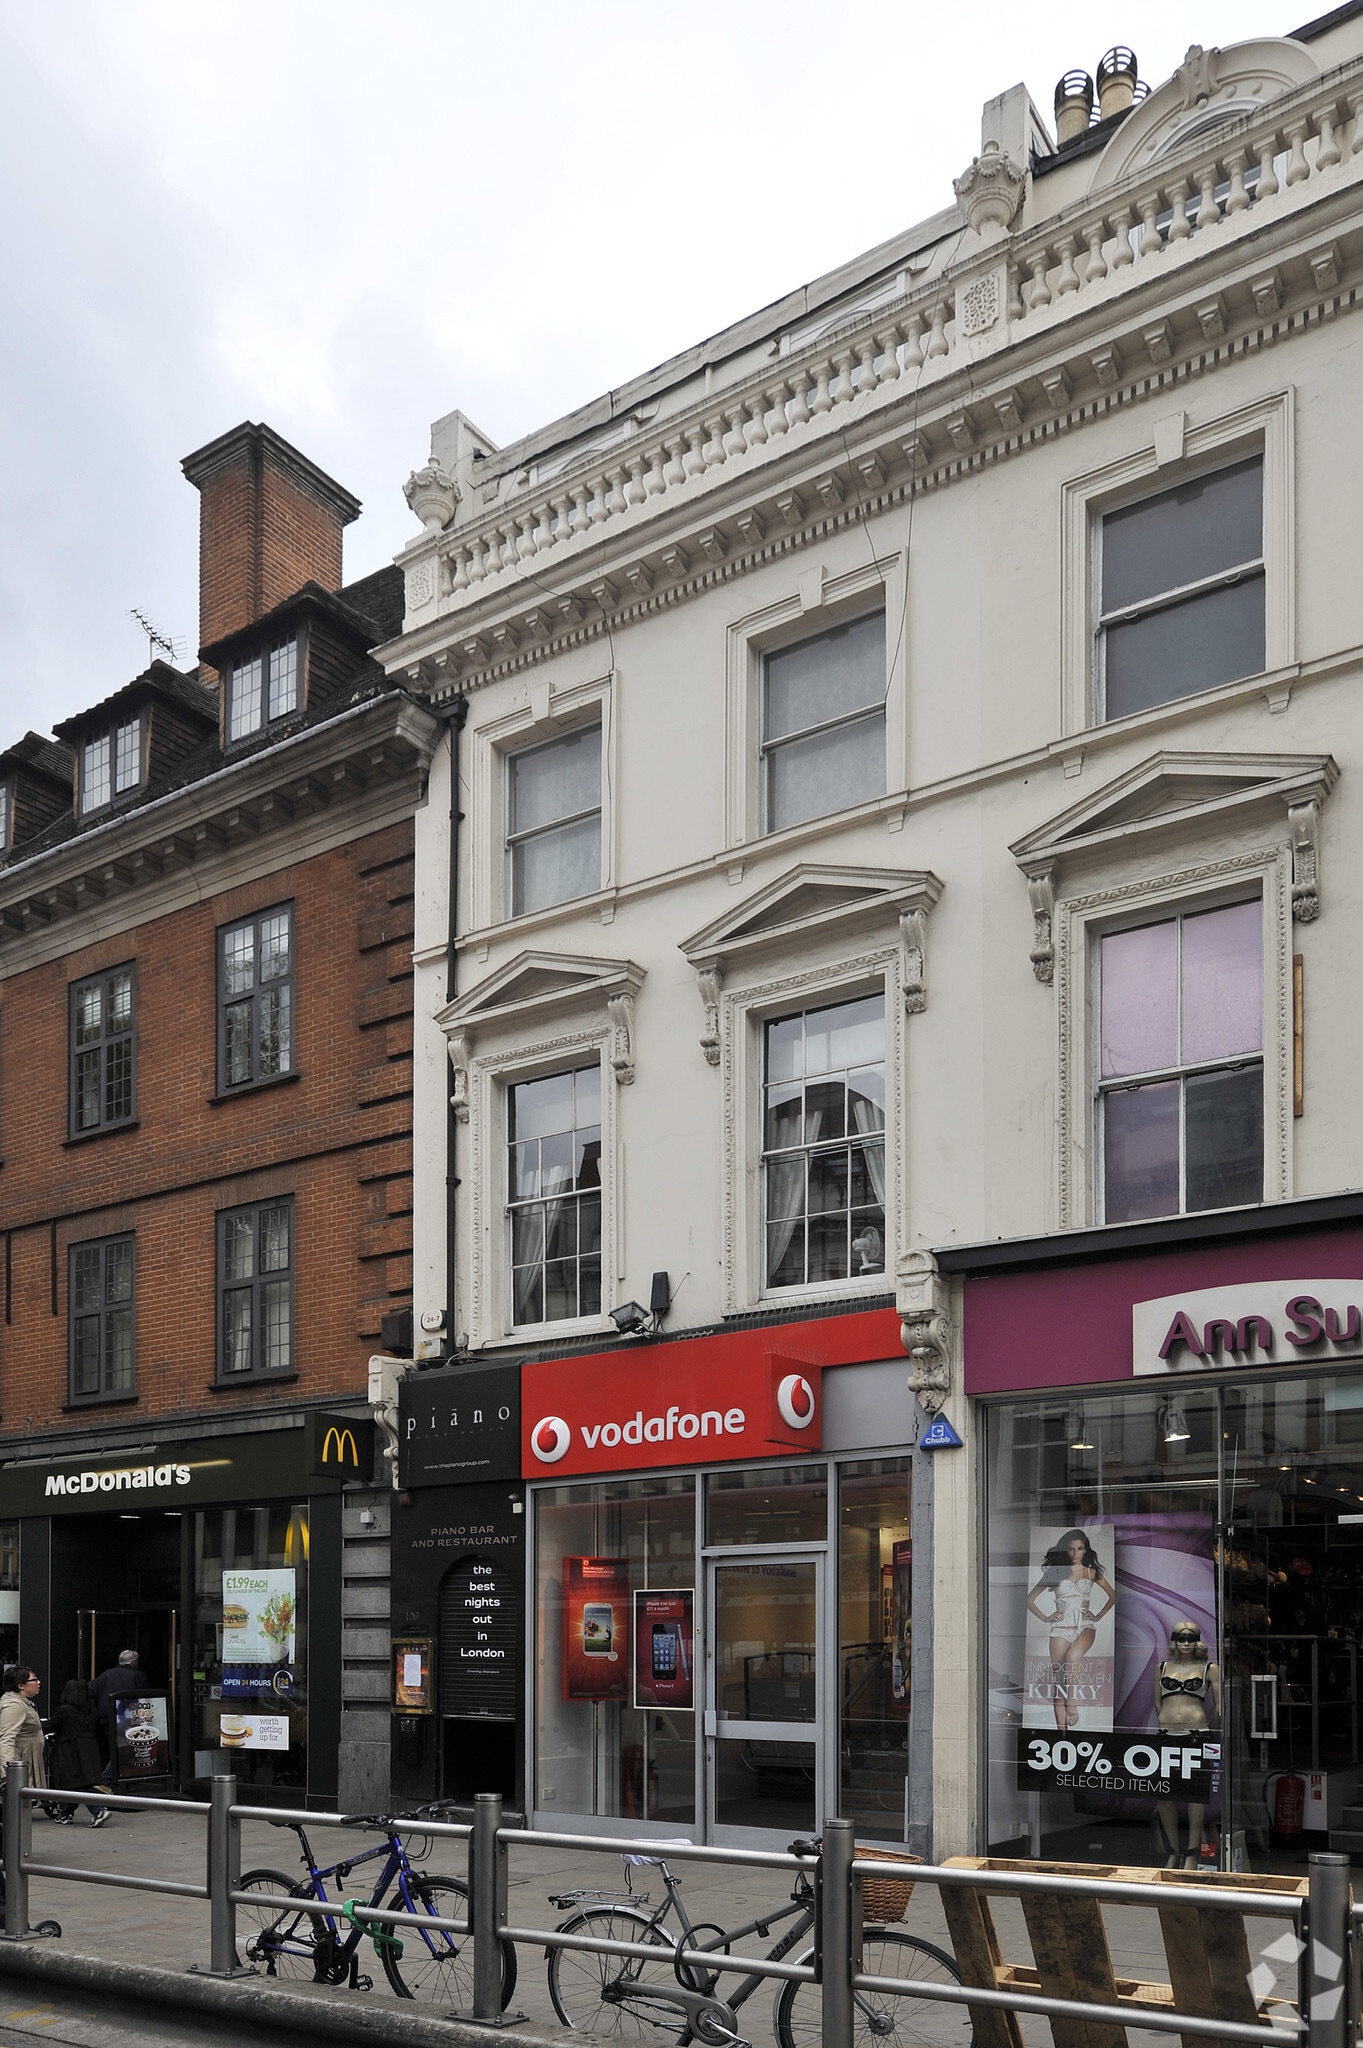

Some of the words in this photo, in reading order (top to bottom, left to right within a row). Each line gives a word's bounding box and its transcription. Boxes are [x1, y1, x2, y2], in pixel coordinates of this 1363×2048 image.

[427, 1315, 440, 1323] 24-7
[1158, 1310, 1272, 1359] Ann
[1285, 1295, 1362, 1346] Su
[580, 1406, 746, 1449] vodafone
[925, 1436, 951, 1445] Chubb
[45, 1464, 191, 1496] McDonald's
[430, 1526, 466, 1536] PIANO
[469, 1525, 495, 1534] BAR
[411, 1540, 434, 1548] AND
[437, 1535, 518, 1547] RESTAURANT
[472, 1565, 493, 1575] the
[226, 1576, 250, 1589] £1.99
[250, 1580, 269, 1589] EACH
[469, 1581, 496, 1591] best
[464, 1597, 501, 1609] nights
[472, 1615, 493, 1624] out
[477, 1631, 488, 1641] in
[460, 1647, 505, 1658] London
[1027, 1662, 1094, 1673] INNOCENT
[1026, 1672, 1060, 1683] UNTIL
[1062, 1673, 1112, 1684] PROVEN
[1027, 1683, 1103, 1700] KINKY
[259, 1717, 279, 1725] worth
[259, 1726, 283, 1734] getting
[259, 1734, 268, 1742] up
[1027, 1739, 1113, 1775] 30%
[1123, 1744, 1202, 1780] OFF
[1056, 1774, 1125, 1790] SELECTED
[1128, 1779, 1171, 1794] ITEMS
